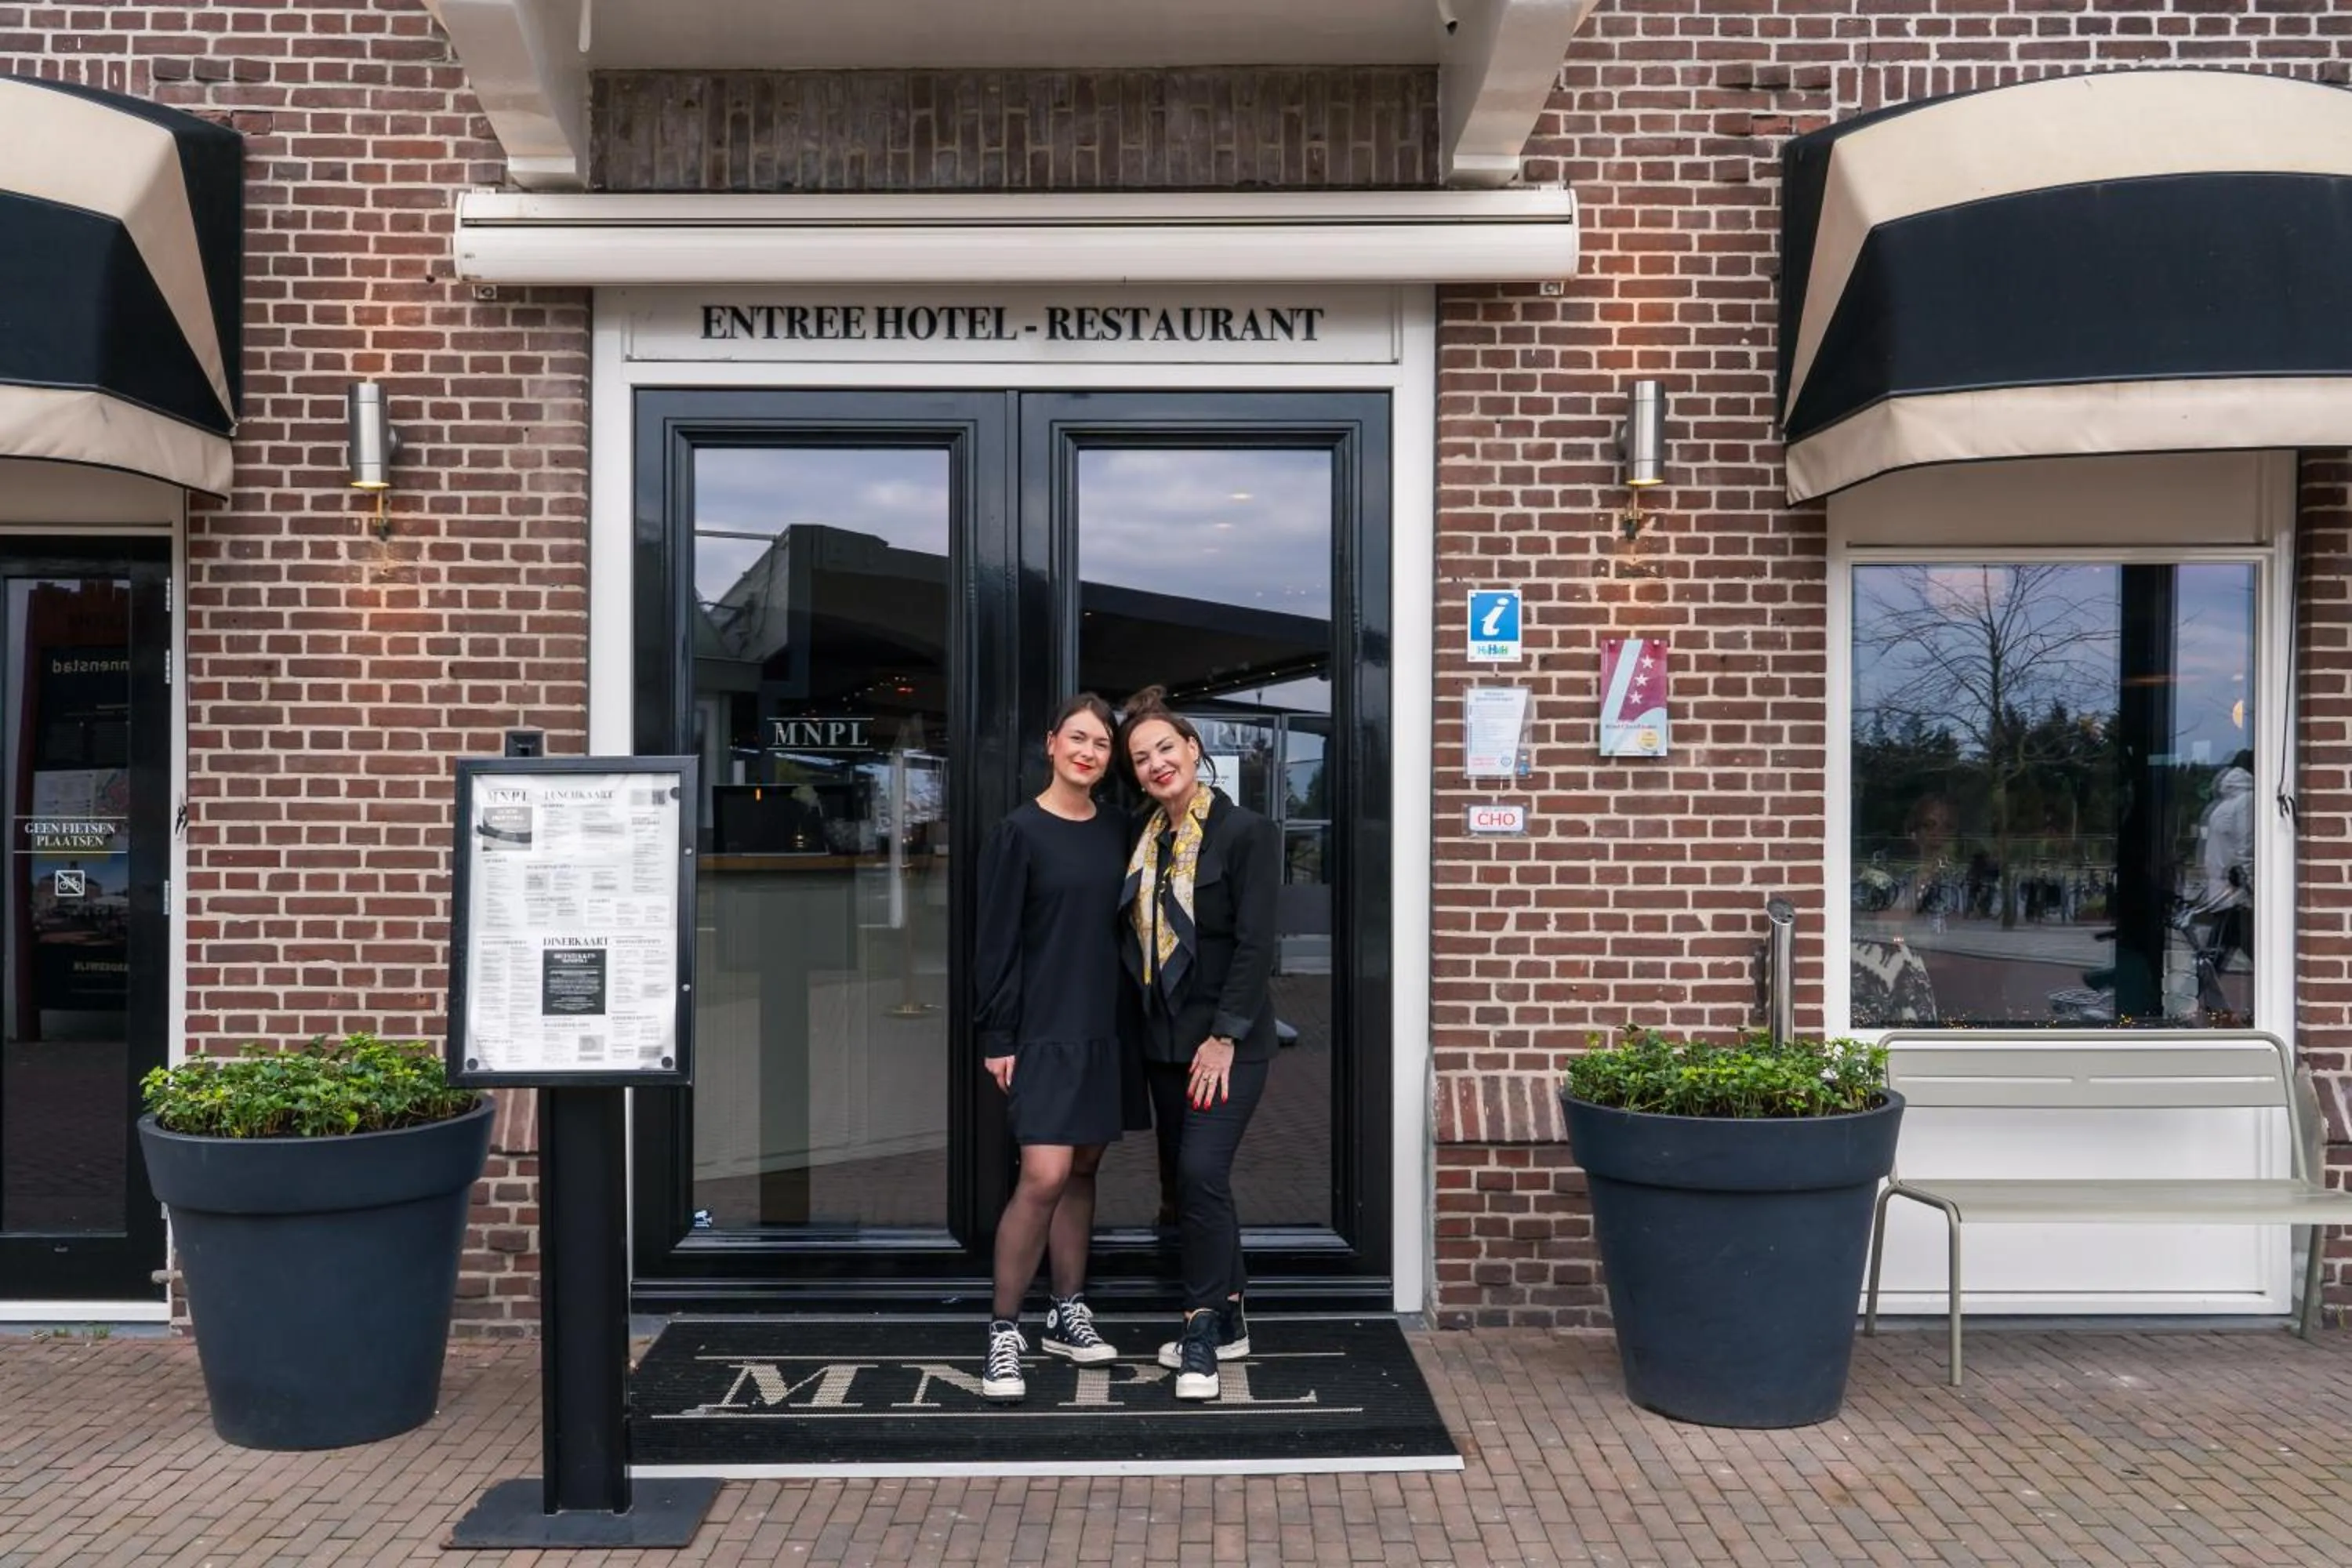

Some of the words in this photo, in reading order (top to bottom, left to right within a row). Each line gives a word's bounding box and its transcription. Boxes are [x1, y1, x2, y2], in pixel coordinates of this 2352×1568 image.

[701, 306, 866, 340] ENTREE
[874, 306, 1018, 340] HOTEL
[1045, 306, 1323, 341] RESTAURANT
[773, 722, 868, 746] MNPL
[1478, 813, 1515, 826] CHO
[24, 822, 60, 833] GEEN
[62, 822, 116, 833] FIETSEN
[36, 835, 104, 847] PLAATSEN
[543, 937, 608, 946] DINERKAART
